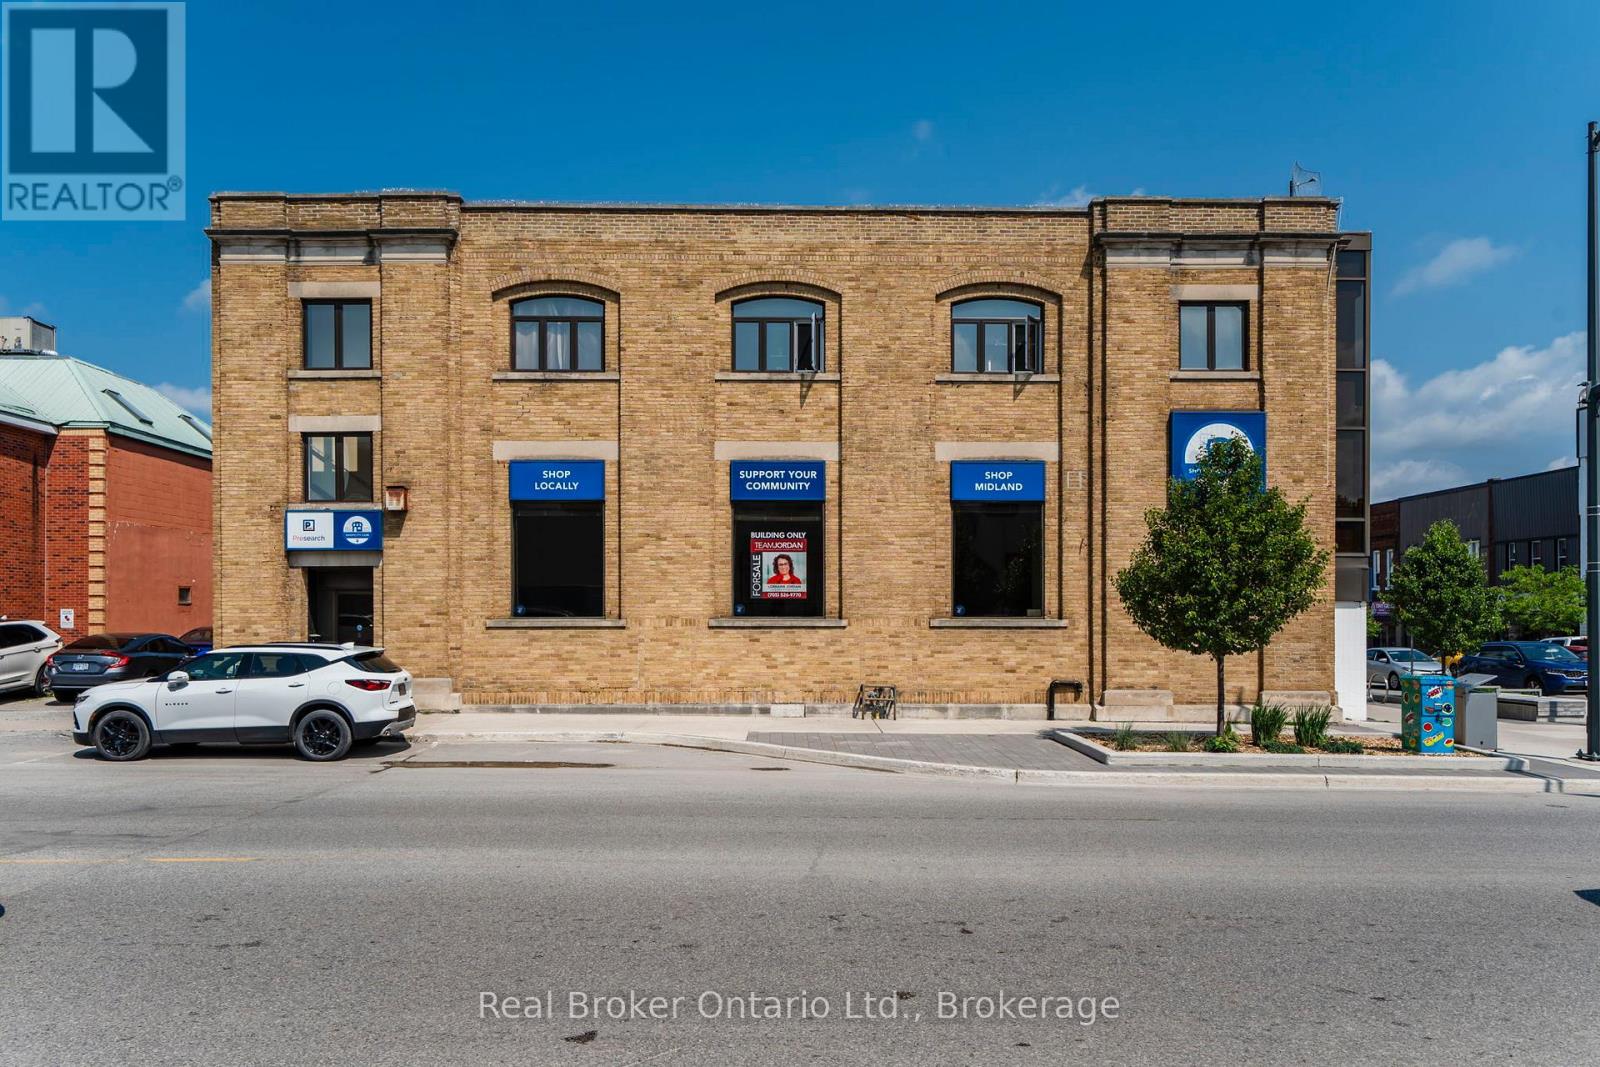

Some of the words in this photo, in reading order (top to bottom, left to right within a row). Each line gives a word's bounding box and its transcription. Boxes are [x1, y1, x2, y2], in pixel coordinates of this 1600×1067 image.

[542, 470, 571, 479] SHOP
[739, 470, 785, 479] SUPPORT
[788, 470, 817, 479] YOUR
[984, 471, 1013, 480] SHOP
[534, 482, 579, 490] LOCALLY
[745, 482, 811, 491] COMMUNITY
[974, 483, 1023, 491] MIDLAND
[750, 531, 786, 539] BUILDING
[786, 531, 807, 539] ONLY
